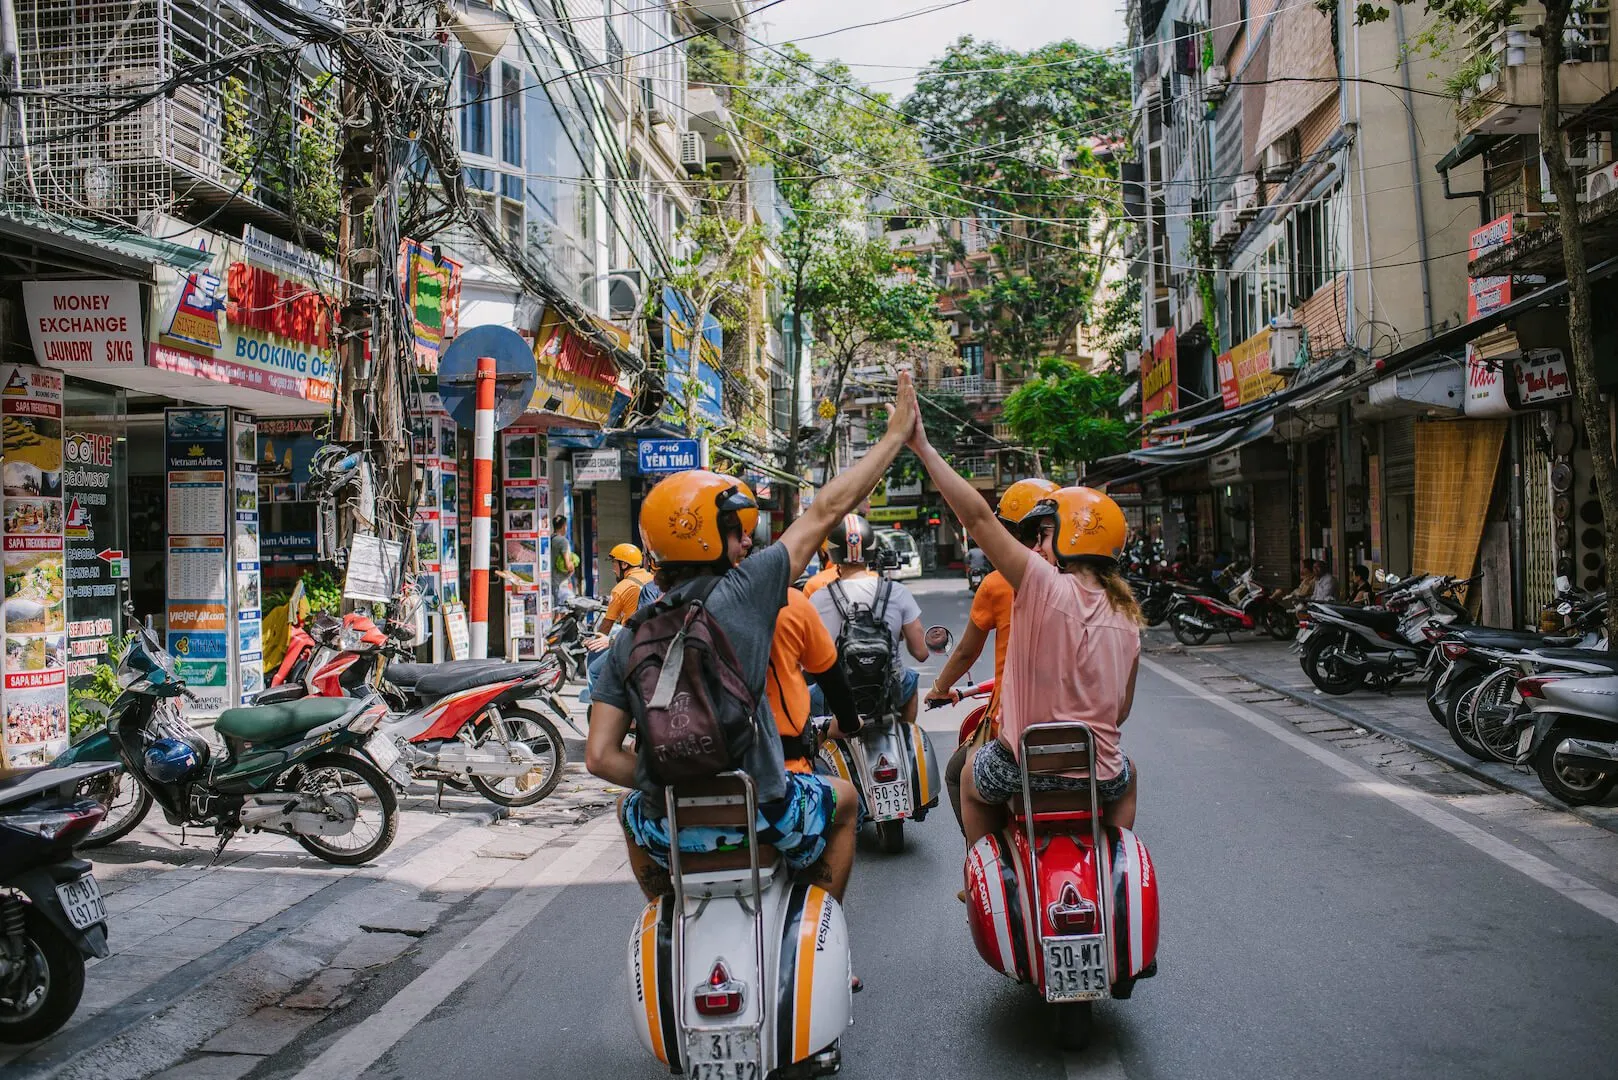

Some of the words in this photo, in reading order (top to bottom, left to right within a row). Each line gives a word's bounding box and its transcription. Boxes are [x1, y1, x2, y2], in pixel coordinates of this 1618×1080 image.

[53, 295, 110, 310] MONEY
[39, 317, 127, 333] EXCHANGE
[176, 315, 197, 335] SINH
[43, 341, 93, 361] LAUNDRY
[106, 339, 133, 362] $/KG
[236, 335, 307, 373] BOOKING
[15, 401, 30, 412] SAPA
[288, 419, 314, 432] BAY
[659, 443, 679, 452] PHỐ
[170, 457, 199, 466] Vietnam
[198, 456, 223, 466] Airlines
[646, 454, 667, 467] YÊN
[669, 452, 693, 466] THÁI
[9, 539, 25, 549] SAPA
[278, 536, 311, 545] Airlines
[190, 640, 220, 652] THAI
[10, 676, 30, 687] SAPA
[30, 674, 43, 685] BAC
[874, 783, 907, 800] 50-S2
[877, 797, 909, 815] 2792
[63, 878, 96, 906] 29-B1
[70, 897, 105, 926] 497.70
